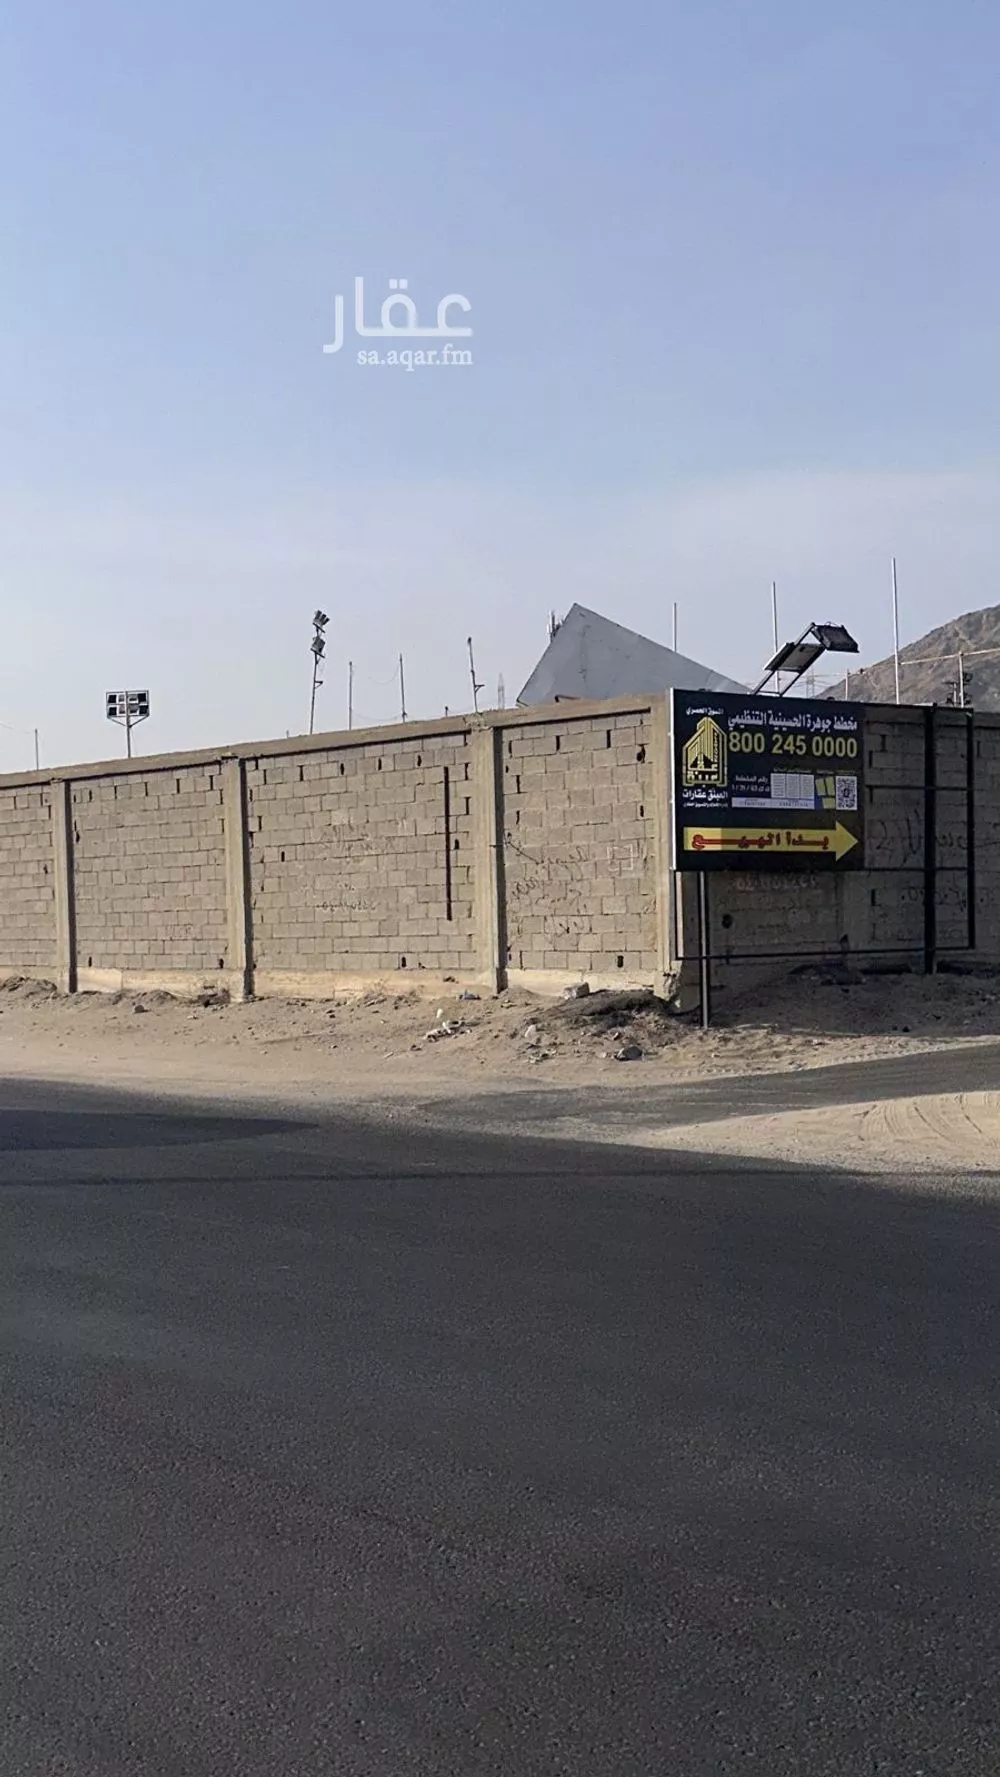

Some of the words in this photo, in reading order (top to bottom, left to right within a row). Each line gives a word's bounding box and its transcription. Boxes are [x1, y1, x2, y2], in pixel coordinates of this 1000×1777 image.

[727, 710, 767, 731] التنظيمي
[768, 710, 805, 731] الحسينية
[806, 714, 831, 733] جوهرة
[833, 716, 857, 731] مخطط
[729, 731, 765, 753] 800
[771, 734, 807, 755] 245
[812, 736, 858, 757] 0000
[682, 789, 706, 800] عقارات
